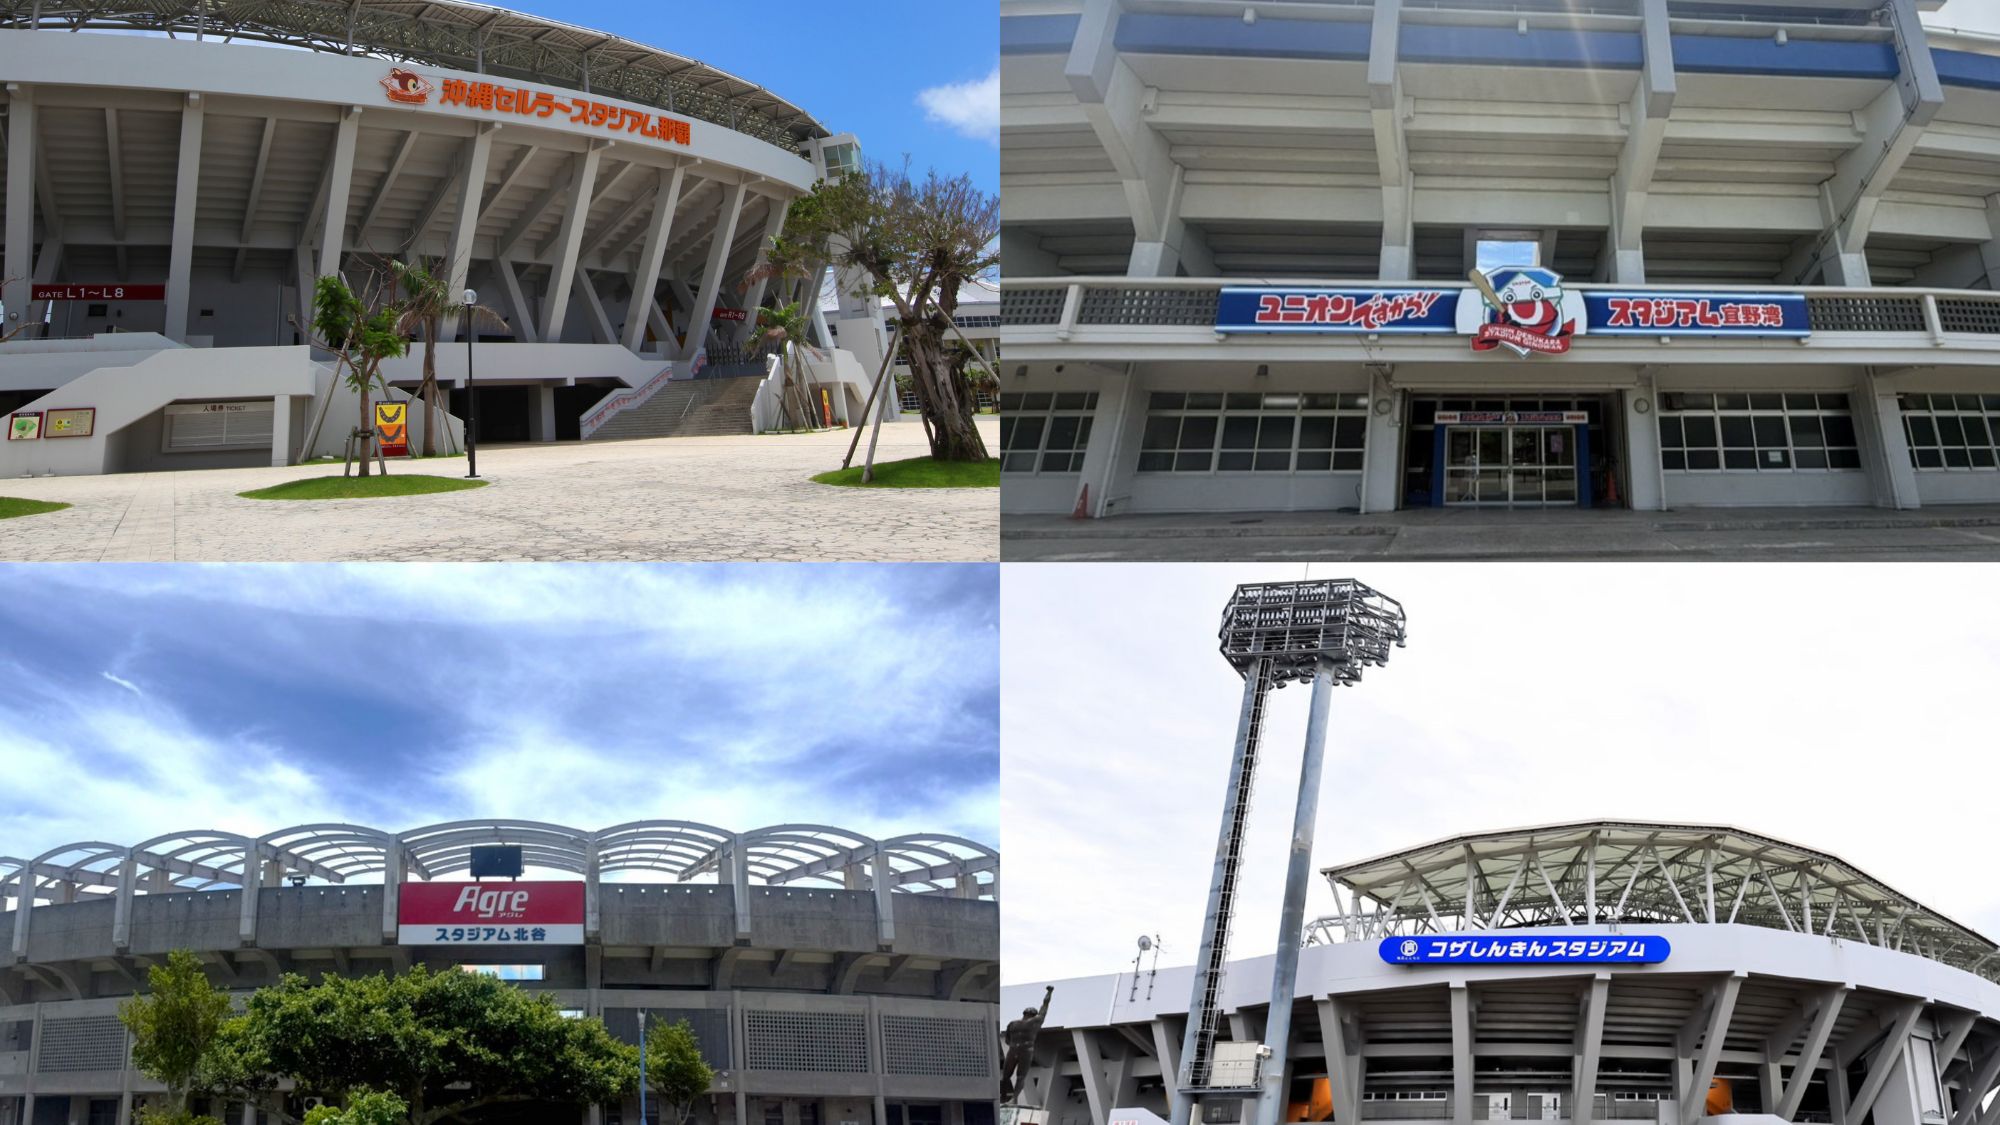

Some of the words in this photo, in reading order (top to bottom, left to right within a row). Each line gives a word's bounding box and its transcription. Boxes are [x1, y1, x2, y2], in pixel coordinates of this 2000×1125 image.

[439, 78, 692, 146] 沖縄セルラースタジアム那覇
[1607, 298, 1784, 327] スタジアム宜野湾
[1484, 329, 1521, 343] STADIUM
[453, 885, 529, 918] Agre
[435, 927, 546, 942] スタジアム北谷
[1427, 940, 1646, 958] コザしんきんスタジアム
